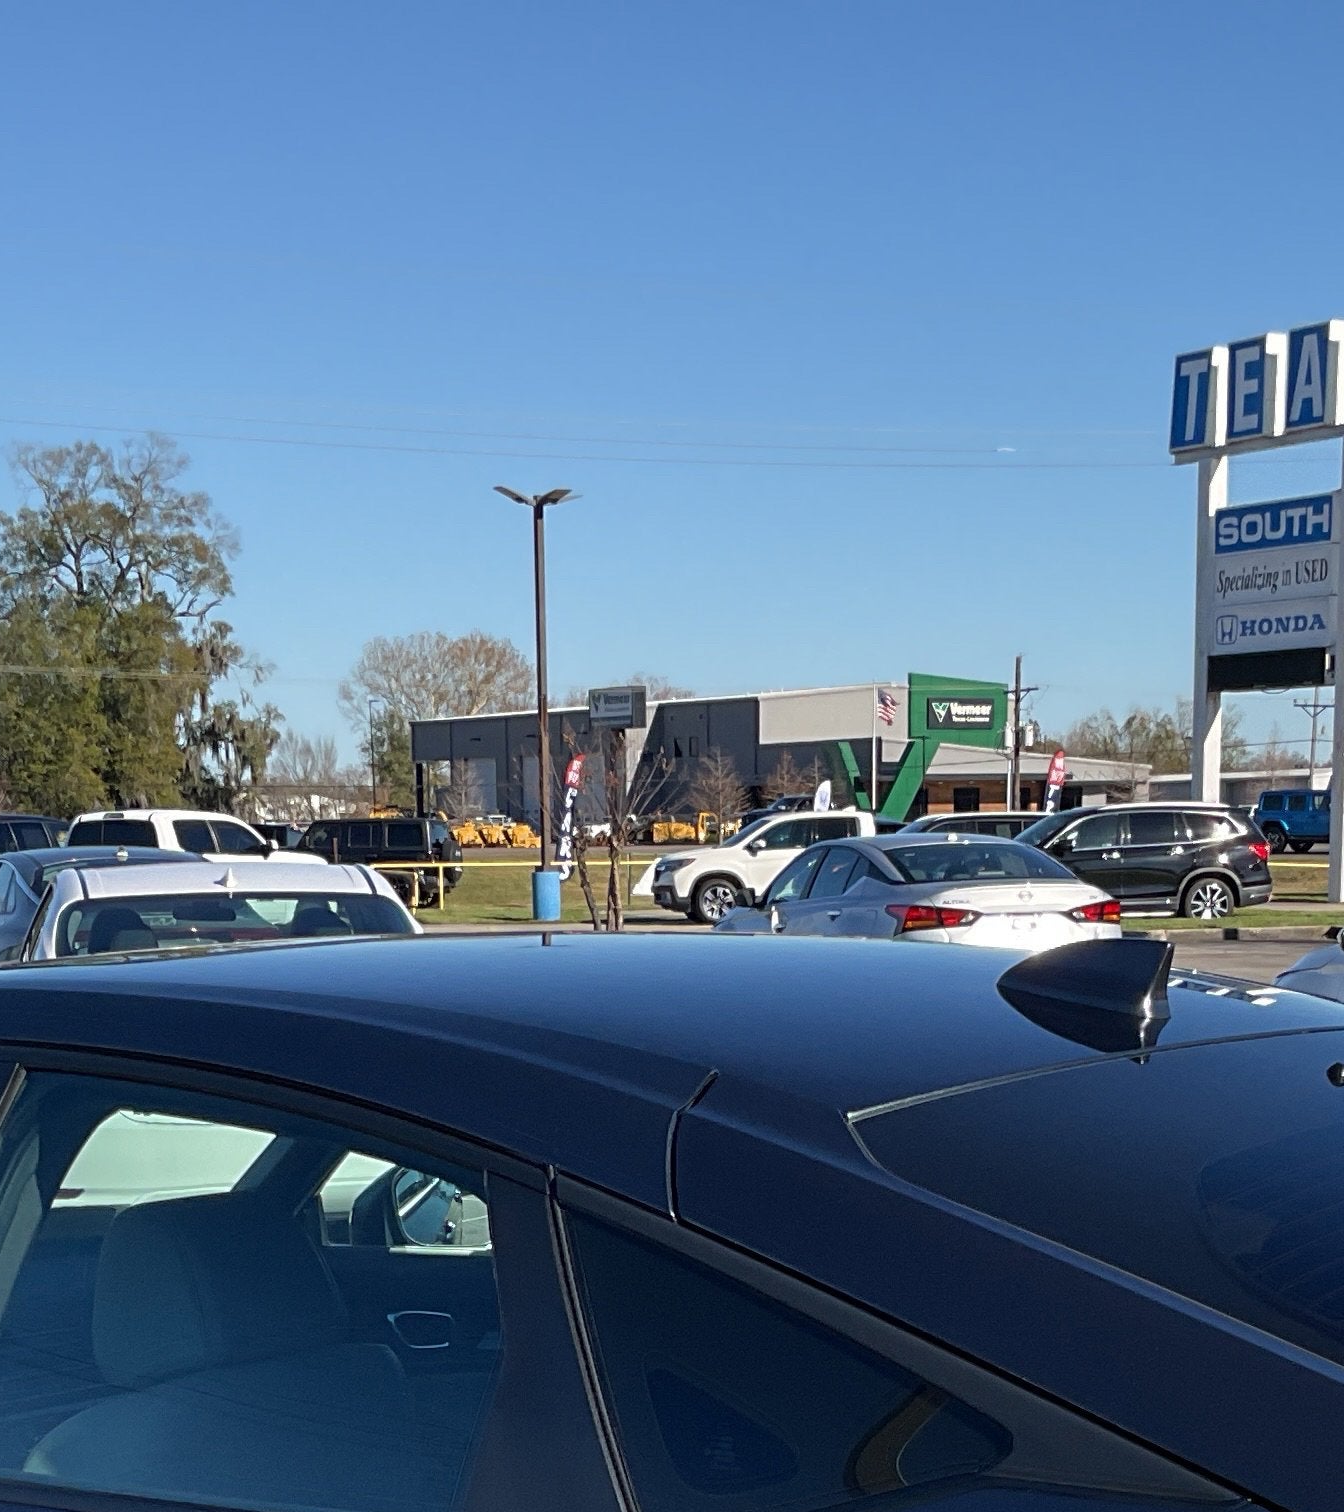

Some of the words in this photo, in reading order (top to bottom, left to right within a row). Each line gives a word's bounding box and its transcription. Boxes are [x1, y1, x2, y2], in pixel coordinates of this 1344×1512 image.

[1218, 503, 1330, 546] SOUTH
[1216, 565, 1279, 599] Specializing
[1281, 562, 1292, 587] in
[1295, 558, 1328, 585] USED
[1239, 613, 1326, 637] HONDA
